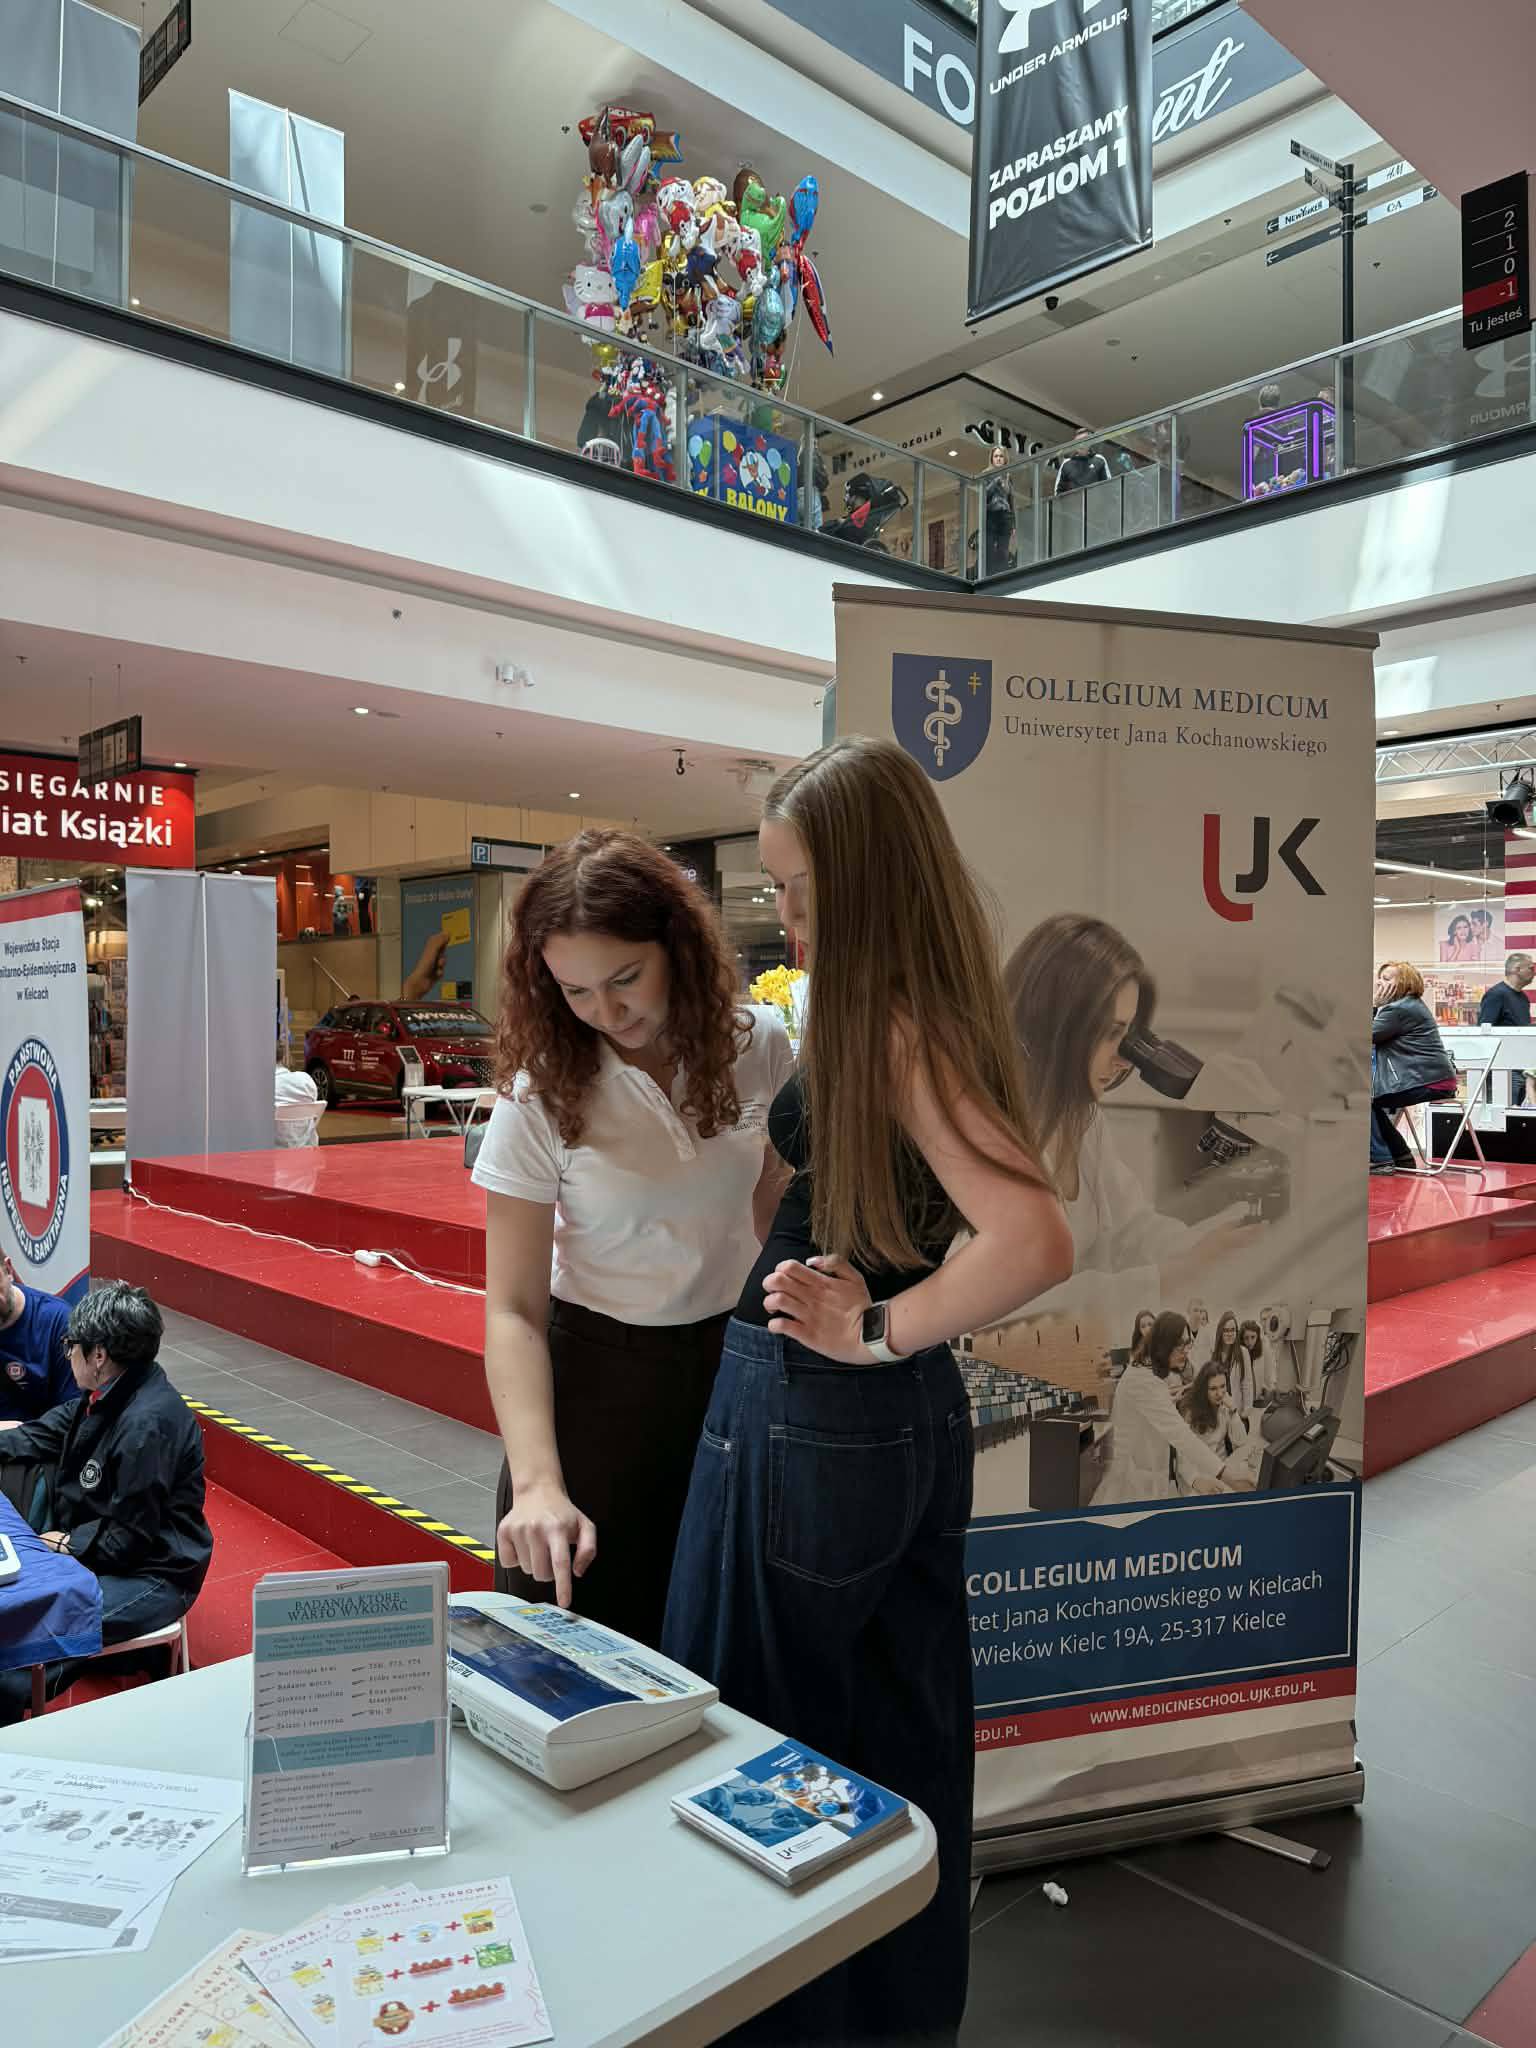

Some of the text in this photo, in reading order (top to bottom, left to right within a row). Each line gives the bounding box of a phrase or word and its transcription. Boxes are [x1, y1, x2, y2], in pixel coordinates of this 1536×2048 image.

[989, 7, 1129, 95] UNDER ARMOUR
[989, 104, 1128, 193] ZAPRASZAMY
[989, 137, 1128, 230] POZIOM 1
[1504, 210, 1515, 228] 2
[1506, 234, 1514, 251] 1
[1504, 257, 1515, 274] 0
[1500, 281, 1515, 298] -1
[1470, 306, 1523, 333] Tu jesteś
[897, 425, 943, 449] OKOLEŃ
[726, 487, 788, 522] BALONY
[1005, 675, 1329, 720] COLLEGIUM MEDICUM
[1004, 714, 1327, 757] Uniwersytet Jana Kochanowskiego
[61, 807, 172, 848] Książki
[1203, 814, 1327, 922] UJK
[41, 936, 60, 952] Stacja
[8, 1040, 58, 1090] PAŃSTWOWA
[1, 1161, 68, 1260] INSPEKCJA SANITARNA
[966, 1544, 1243, 1597] COLLEGIUM MEDICUM
[288, 1607, 336, 1621] WARTO
[968, 1570, 1322, 1634] tet Jana Kochanowskiego w Kielcach
[972, 1610, 1287, 1666] Wieków Kielc 19A, 25-317 Kielce
[974, 1680, 1317, 1743] EDU.PL WWW.MEDICINESCHOOL.UJK.EDU.PL
